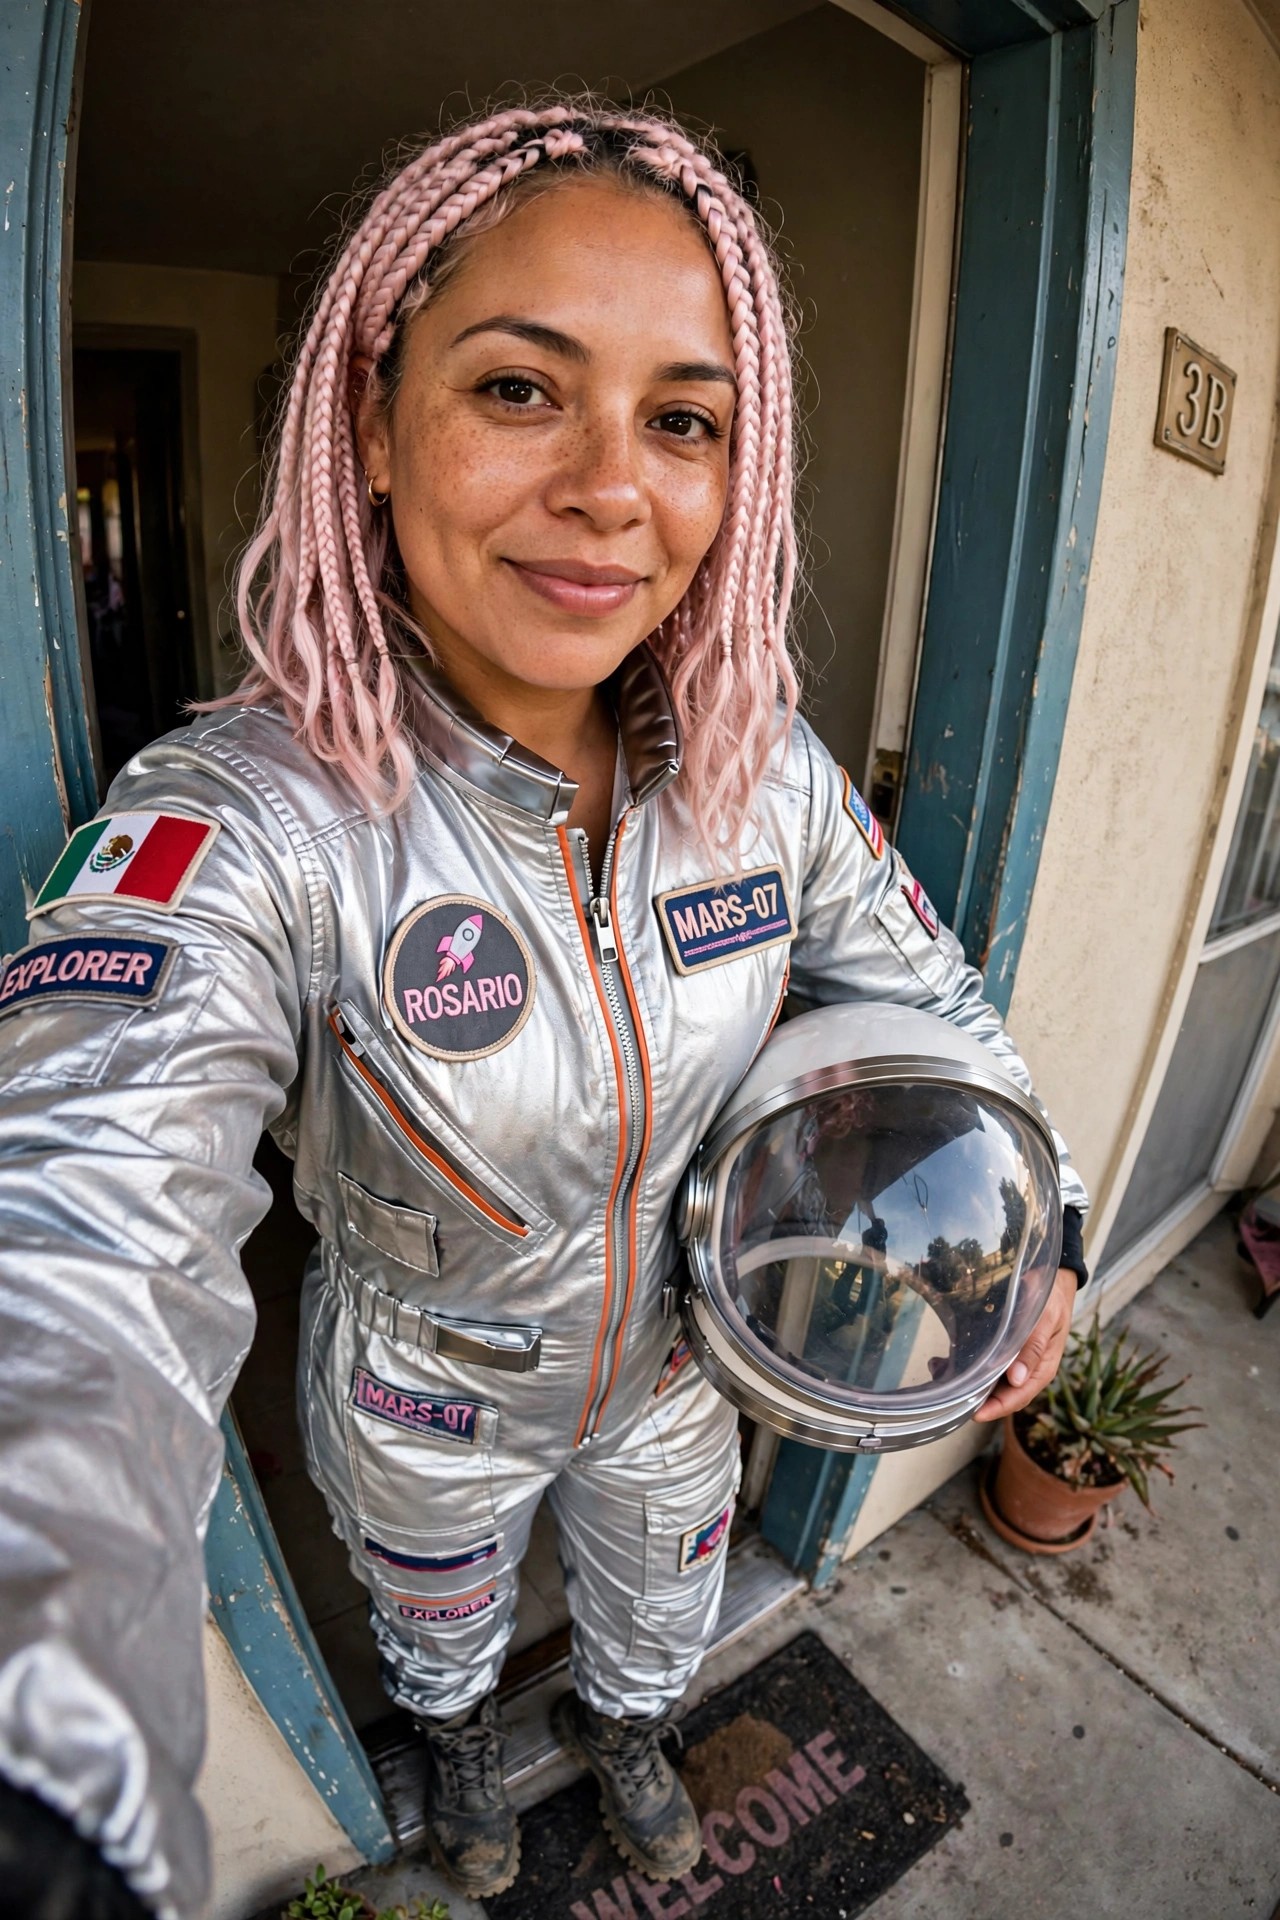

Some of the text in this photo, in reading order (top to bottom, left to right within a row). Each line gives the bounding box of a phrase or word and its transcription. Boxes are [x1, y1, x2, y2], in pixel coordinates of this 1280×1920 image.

[1177, 361, 1227, 449] 3B
[672, 882, 777, 942] MARS-07
[0, 949, 153, 1001] EXPLORER
[403, 973, 523, 1024] ROSARIO
[401, 1595, 492, 1621] EXPLORER
